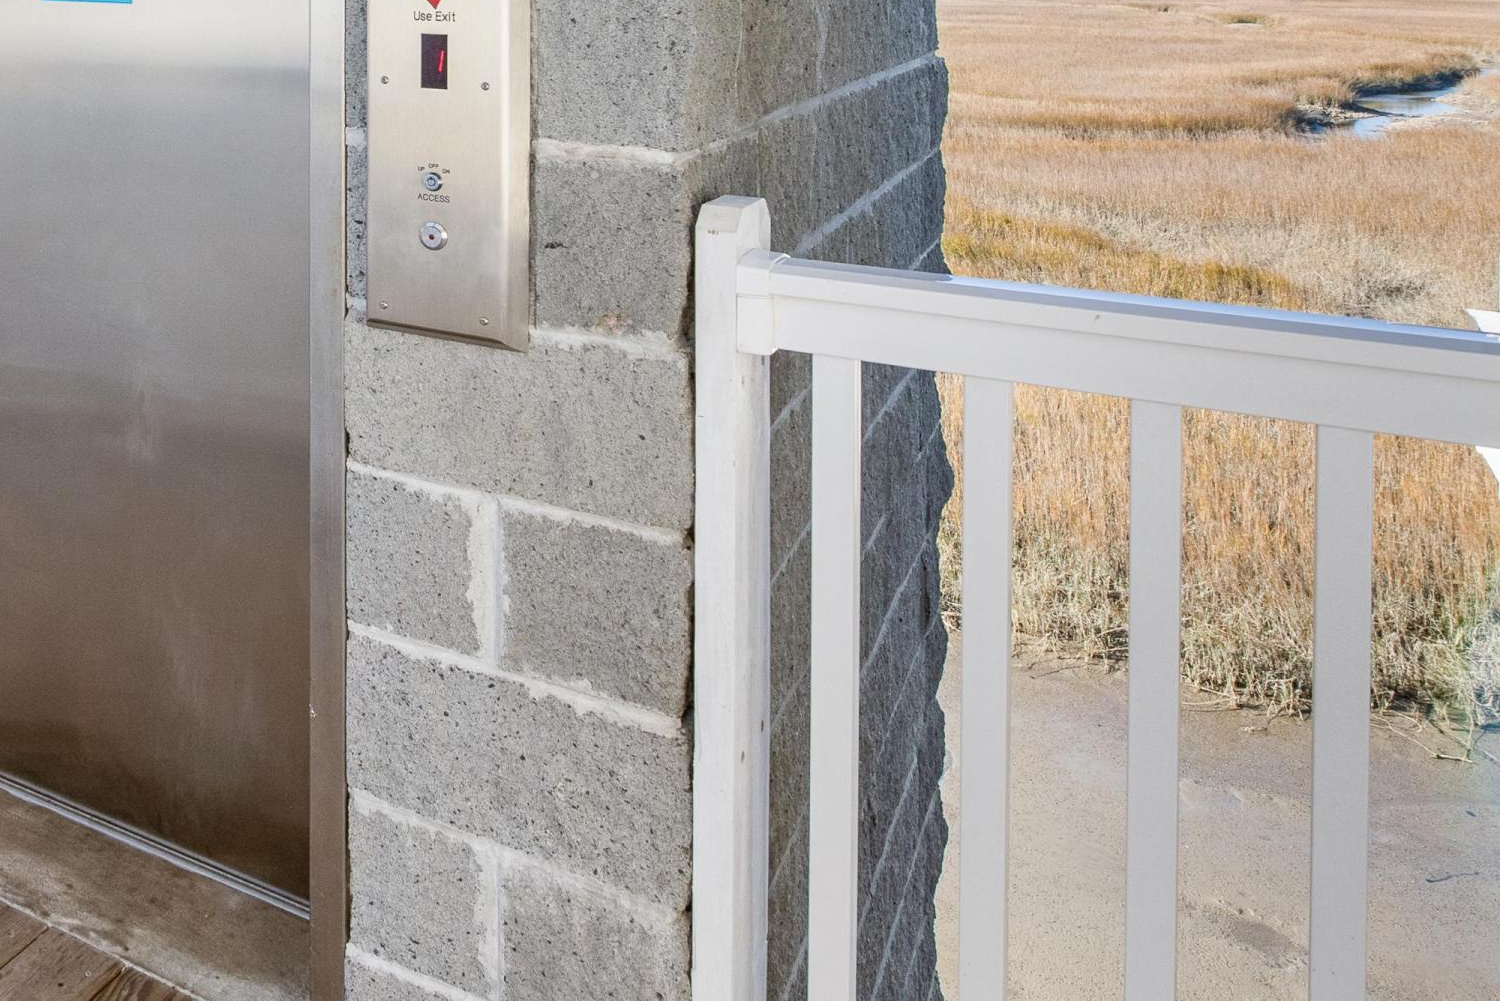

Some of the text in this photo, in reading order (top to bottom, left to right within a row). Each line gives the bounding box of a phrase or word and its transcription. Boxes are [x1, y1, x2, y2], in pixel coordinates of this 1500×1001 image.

[413, 10, 456, 22] Use Exit
[437, 50, 446, 73] 1
[417, 193, 451, 204] ACCESS
